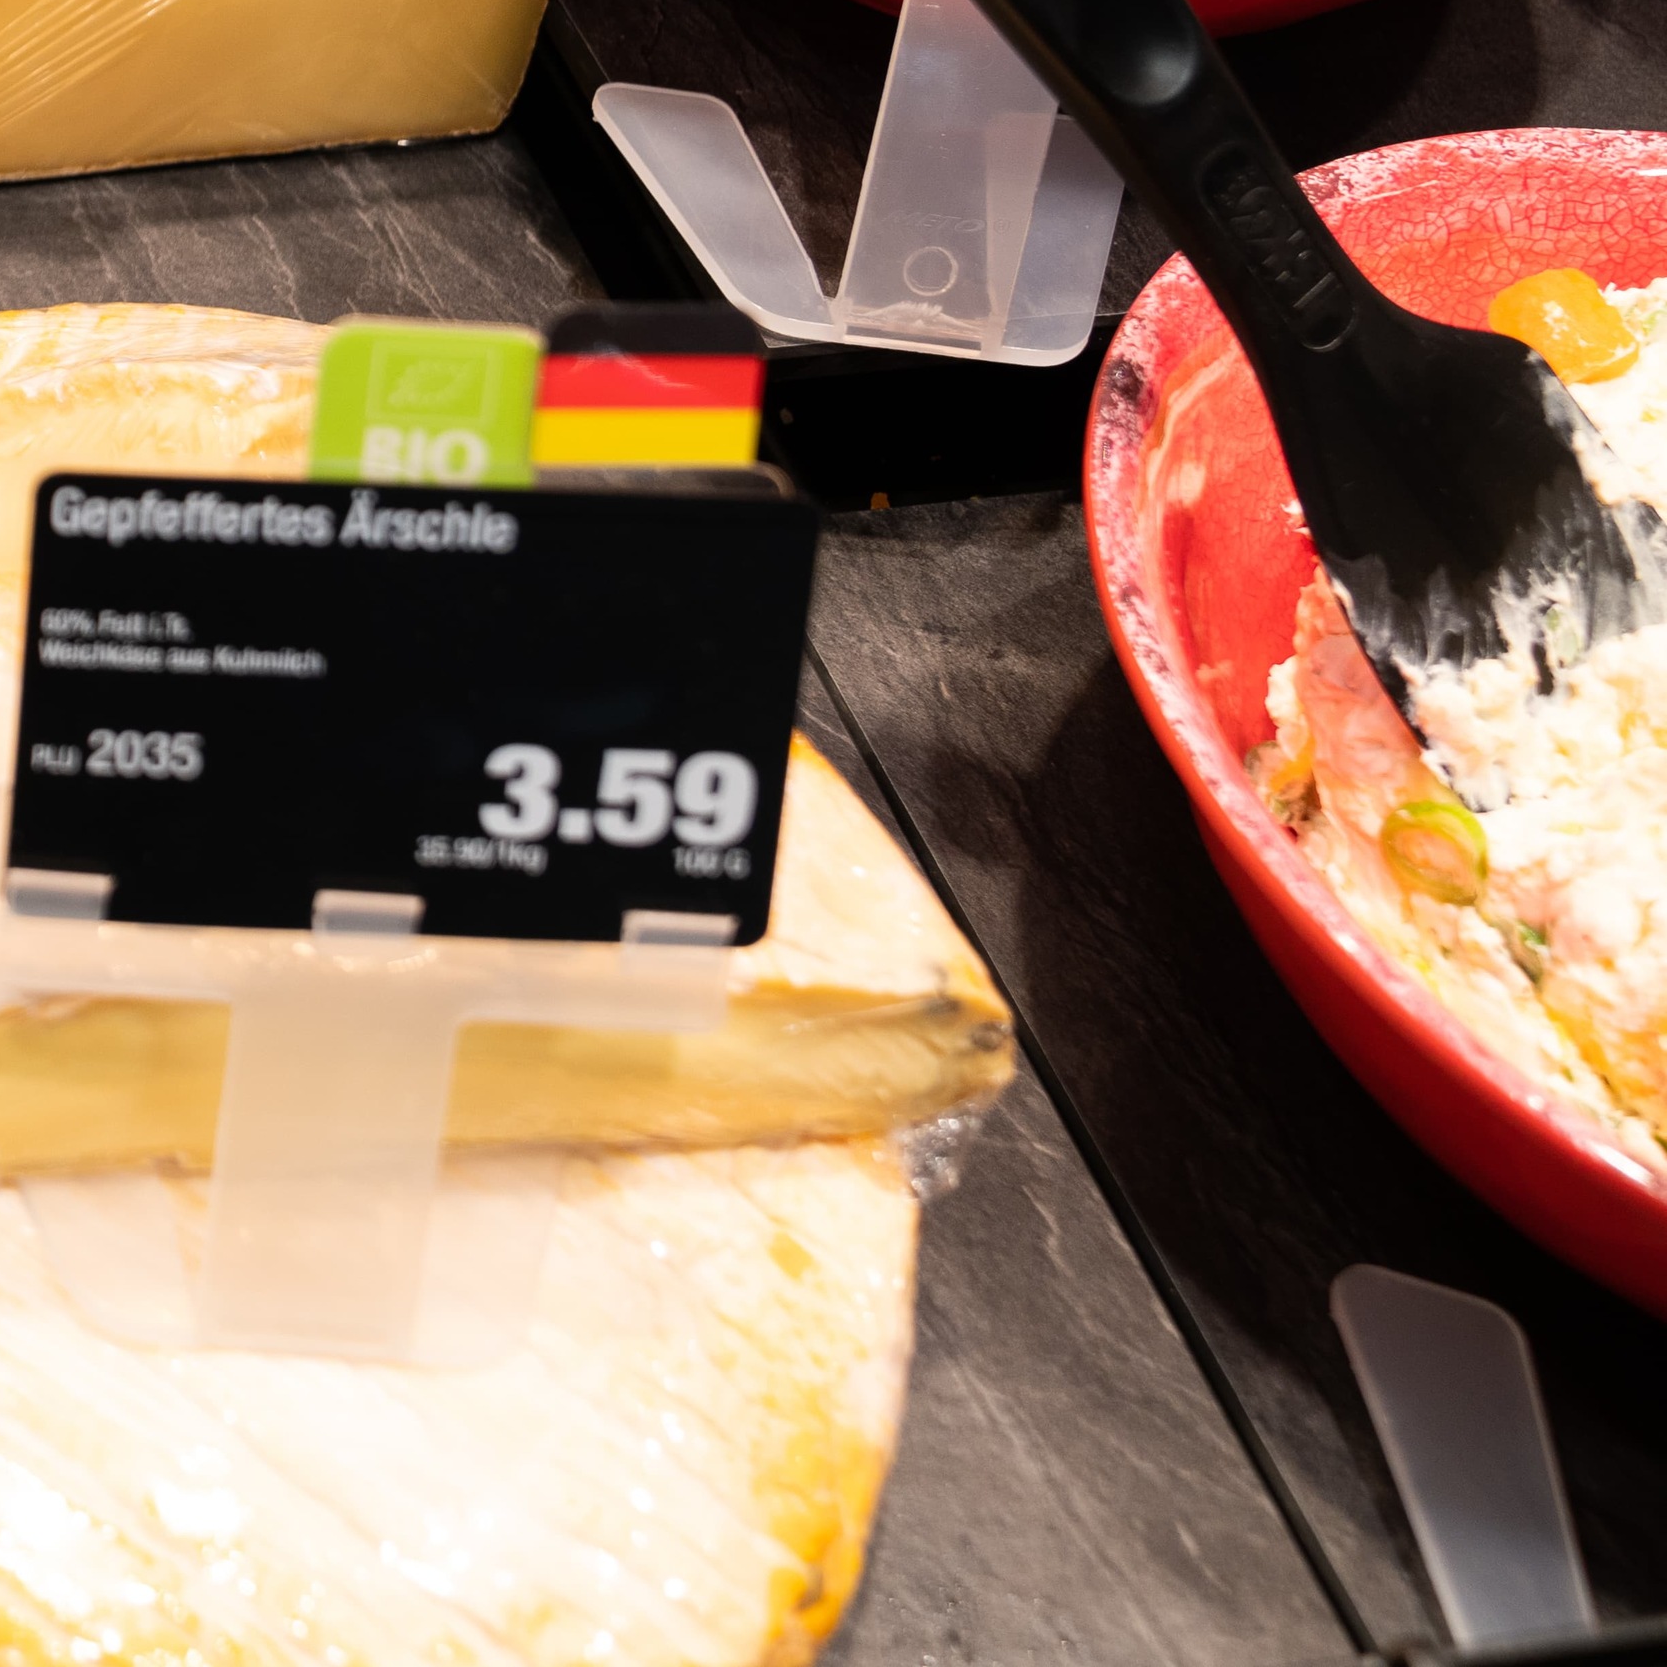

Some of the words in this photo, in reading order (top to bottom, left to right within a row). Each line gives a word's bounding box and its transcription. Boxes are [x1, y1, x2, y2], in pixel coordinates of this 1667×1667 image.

[360, 426, 487, 486] BIO
[50, 486, 333, 545] Gepfeffertes
[339, 490, 517, 552] Ärschle
[86, 729, 203, 779] 2035
[477, 742, 759, 848] 3.59
